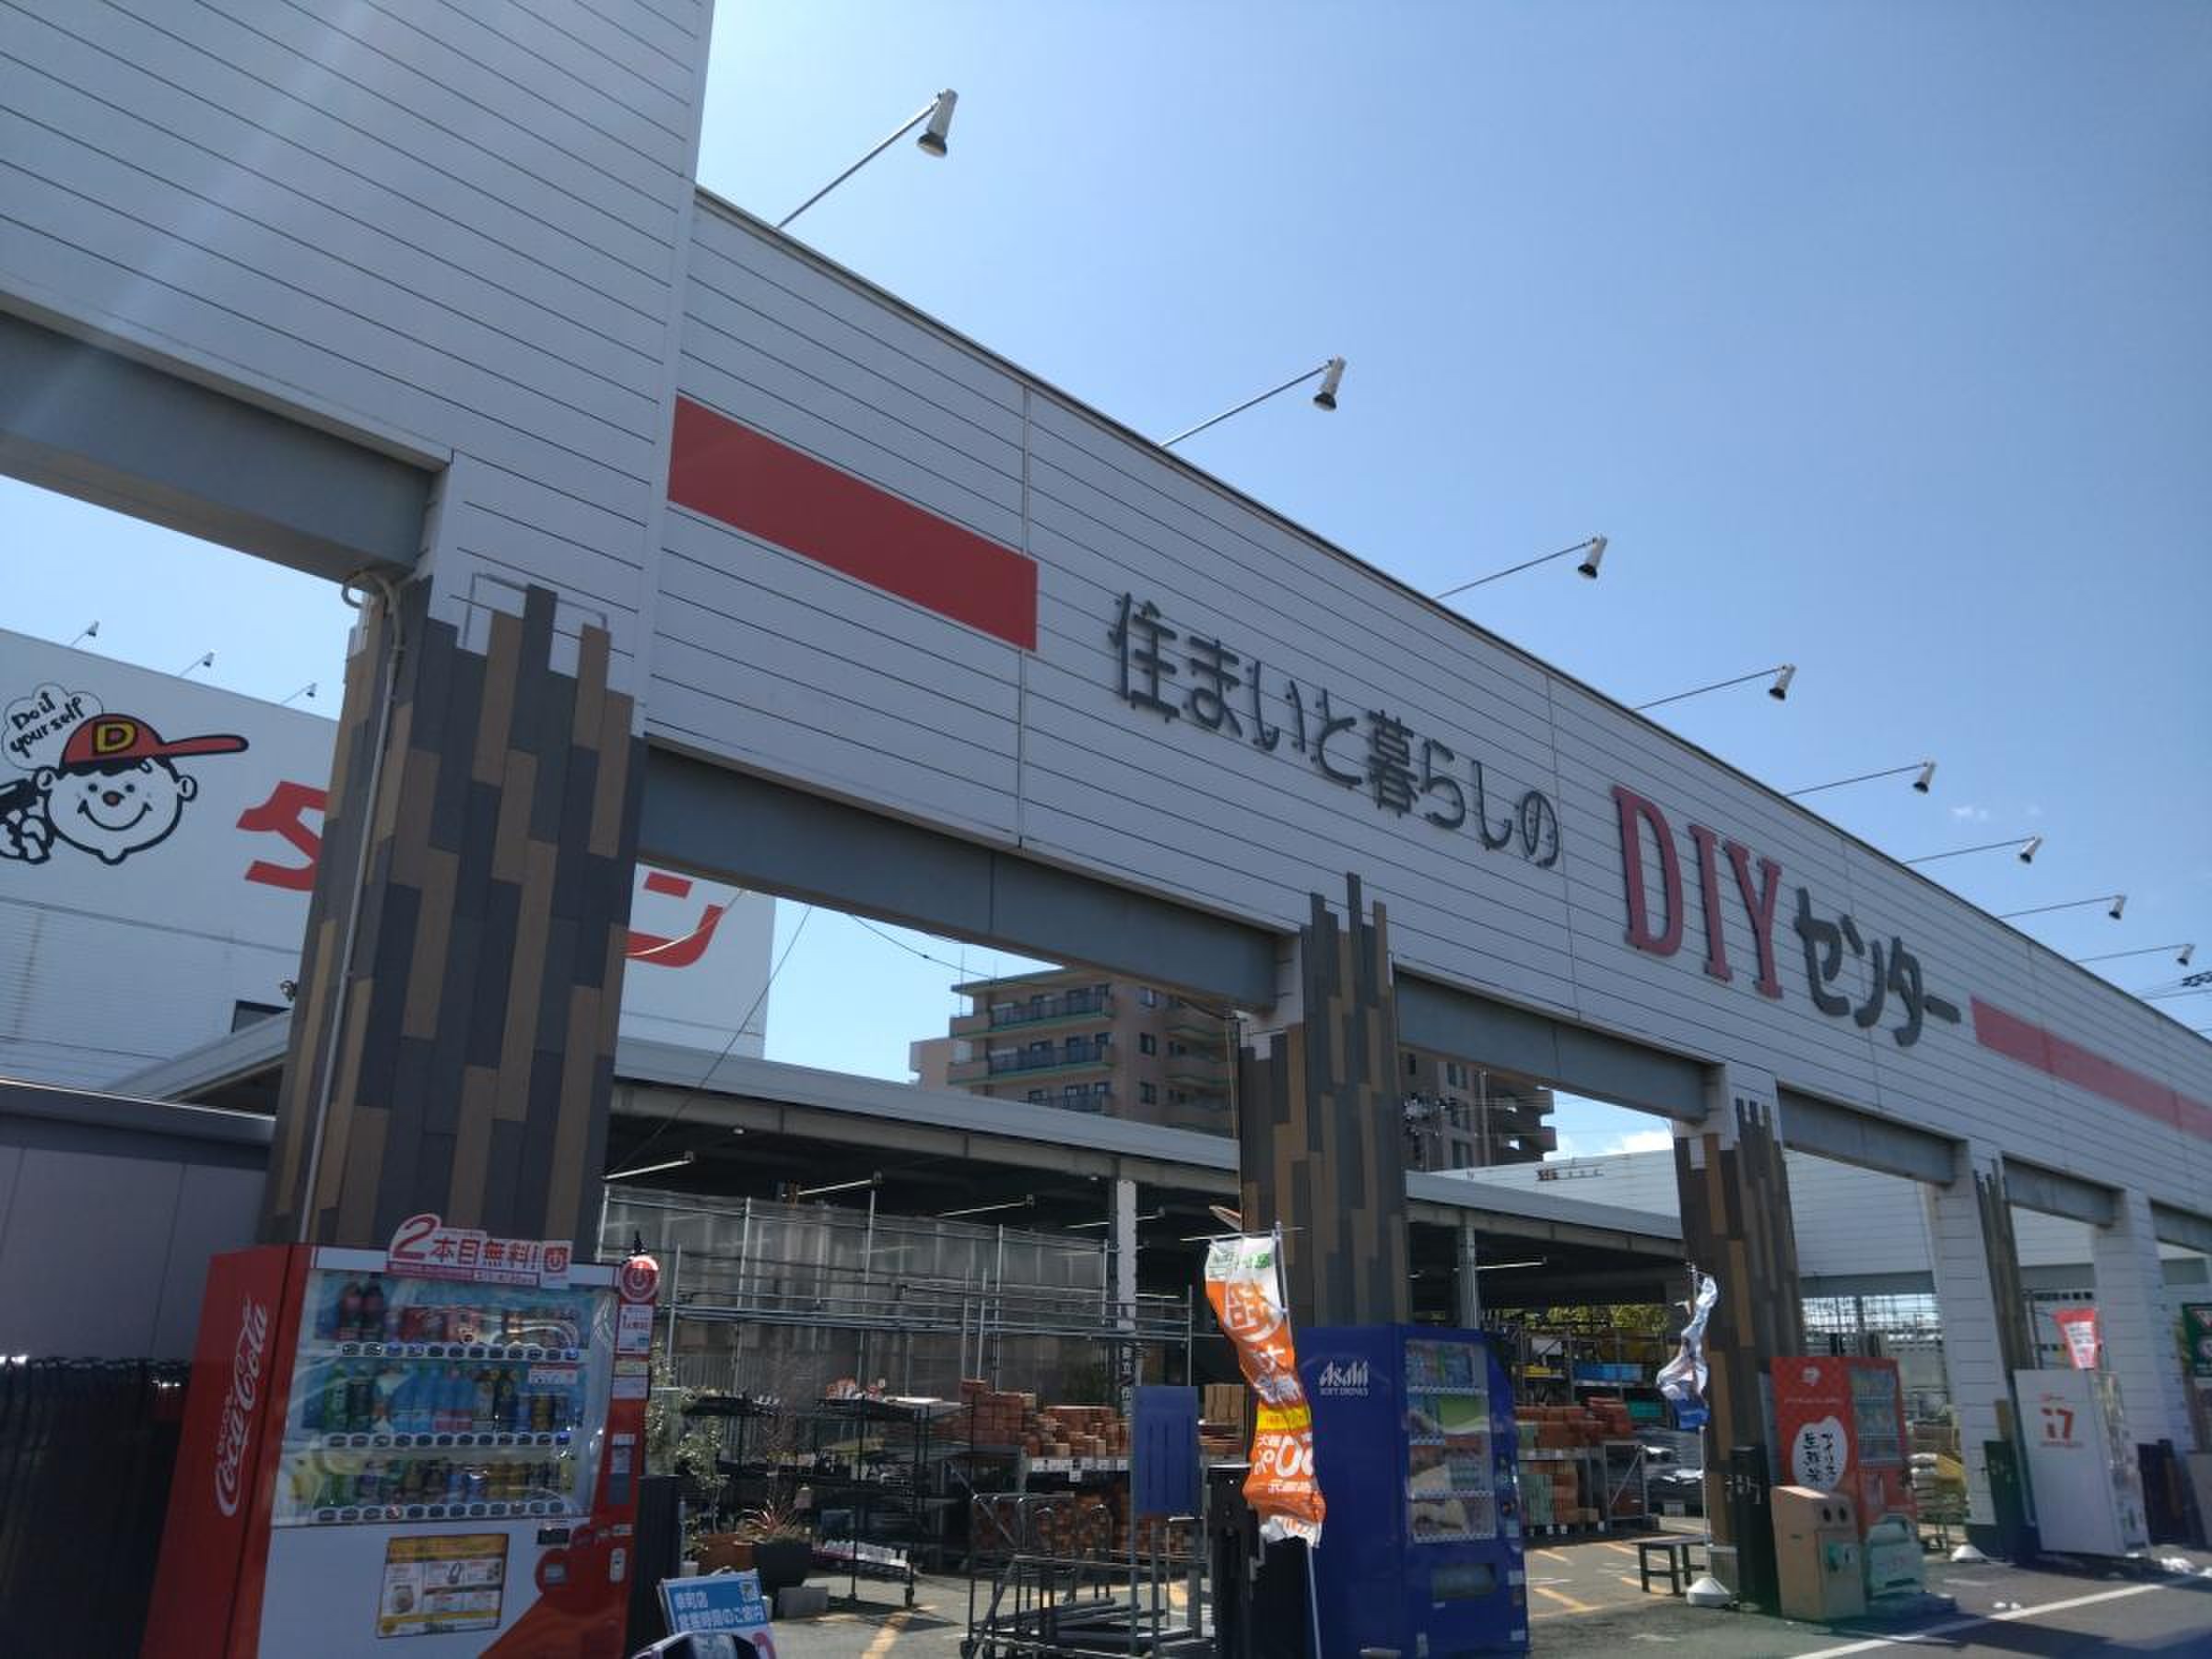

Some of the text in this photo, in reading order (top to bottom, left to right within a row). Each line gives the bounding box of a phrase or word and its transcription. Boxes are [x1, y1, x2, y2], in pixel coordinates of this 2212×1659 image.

[10, 696, 85, 759] yourself
[11, 707, 40, 731] Do
[96, 722, 137, 753] D
[1108, 592, 1962, 1048] 住まいと暮らしの DIY センター
[1319, 1359, 1369, 1387] Asahi
